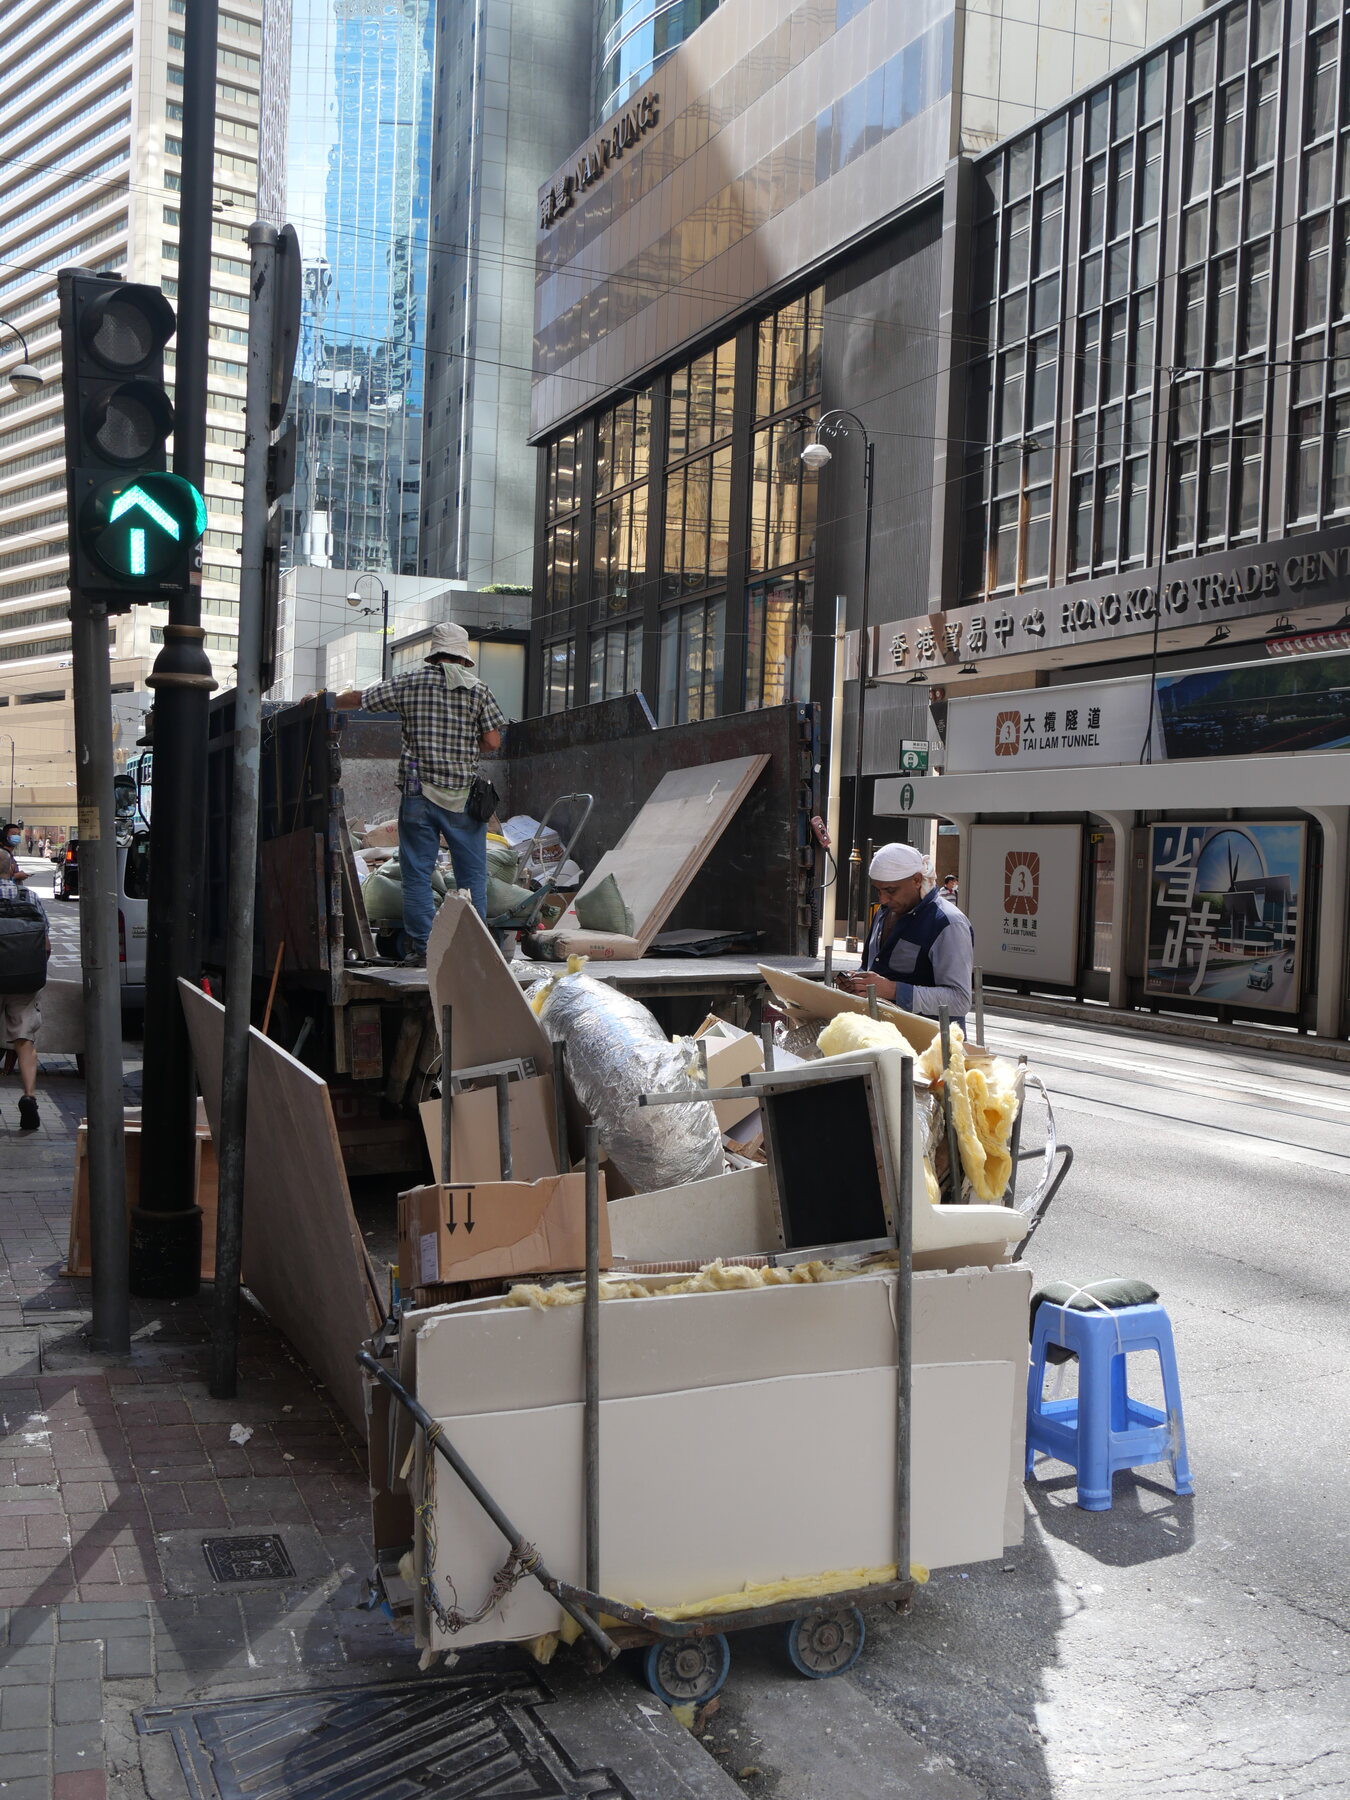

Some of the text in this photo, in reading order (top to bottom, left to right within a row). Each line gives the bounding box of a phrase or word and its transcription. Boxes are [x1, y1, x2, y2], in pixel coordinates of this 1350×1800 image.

[1059, 592, 1121, 631] HONG
[1191, 563, 1278, 610] TRADE
[889, 608, 1045, 666] 香港貿易中心
[1005, 725, 1011, 740] 3
[1023, 707, 1101, 734] 大欖隧道
[1022, 734, 1100, 750] TAI LAM TUNNEL
[1018, 871, 1026, 892] 3
[1154, 826, 1221, 996] 省時
